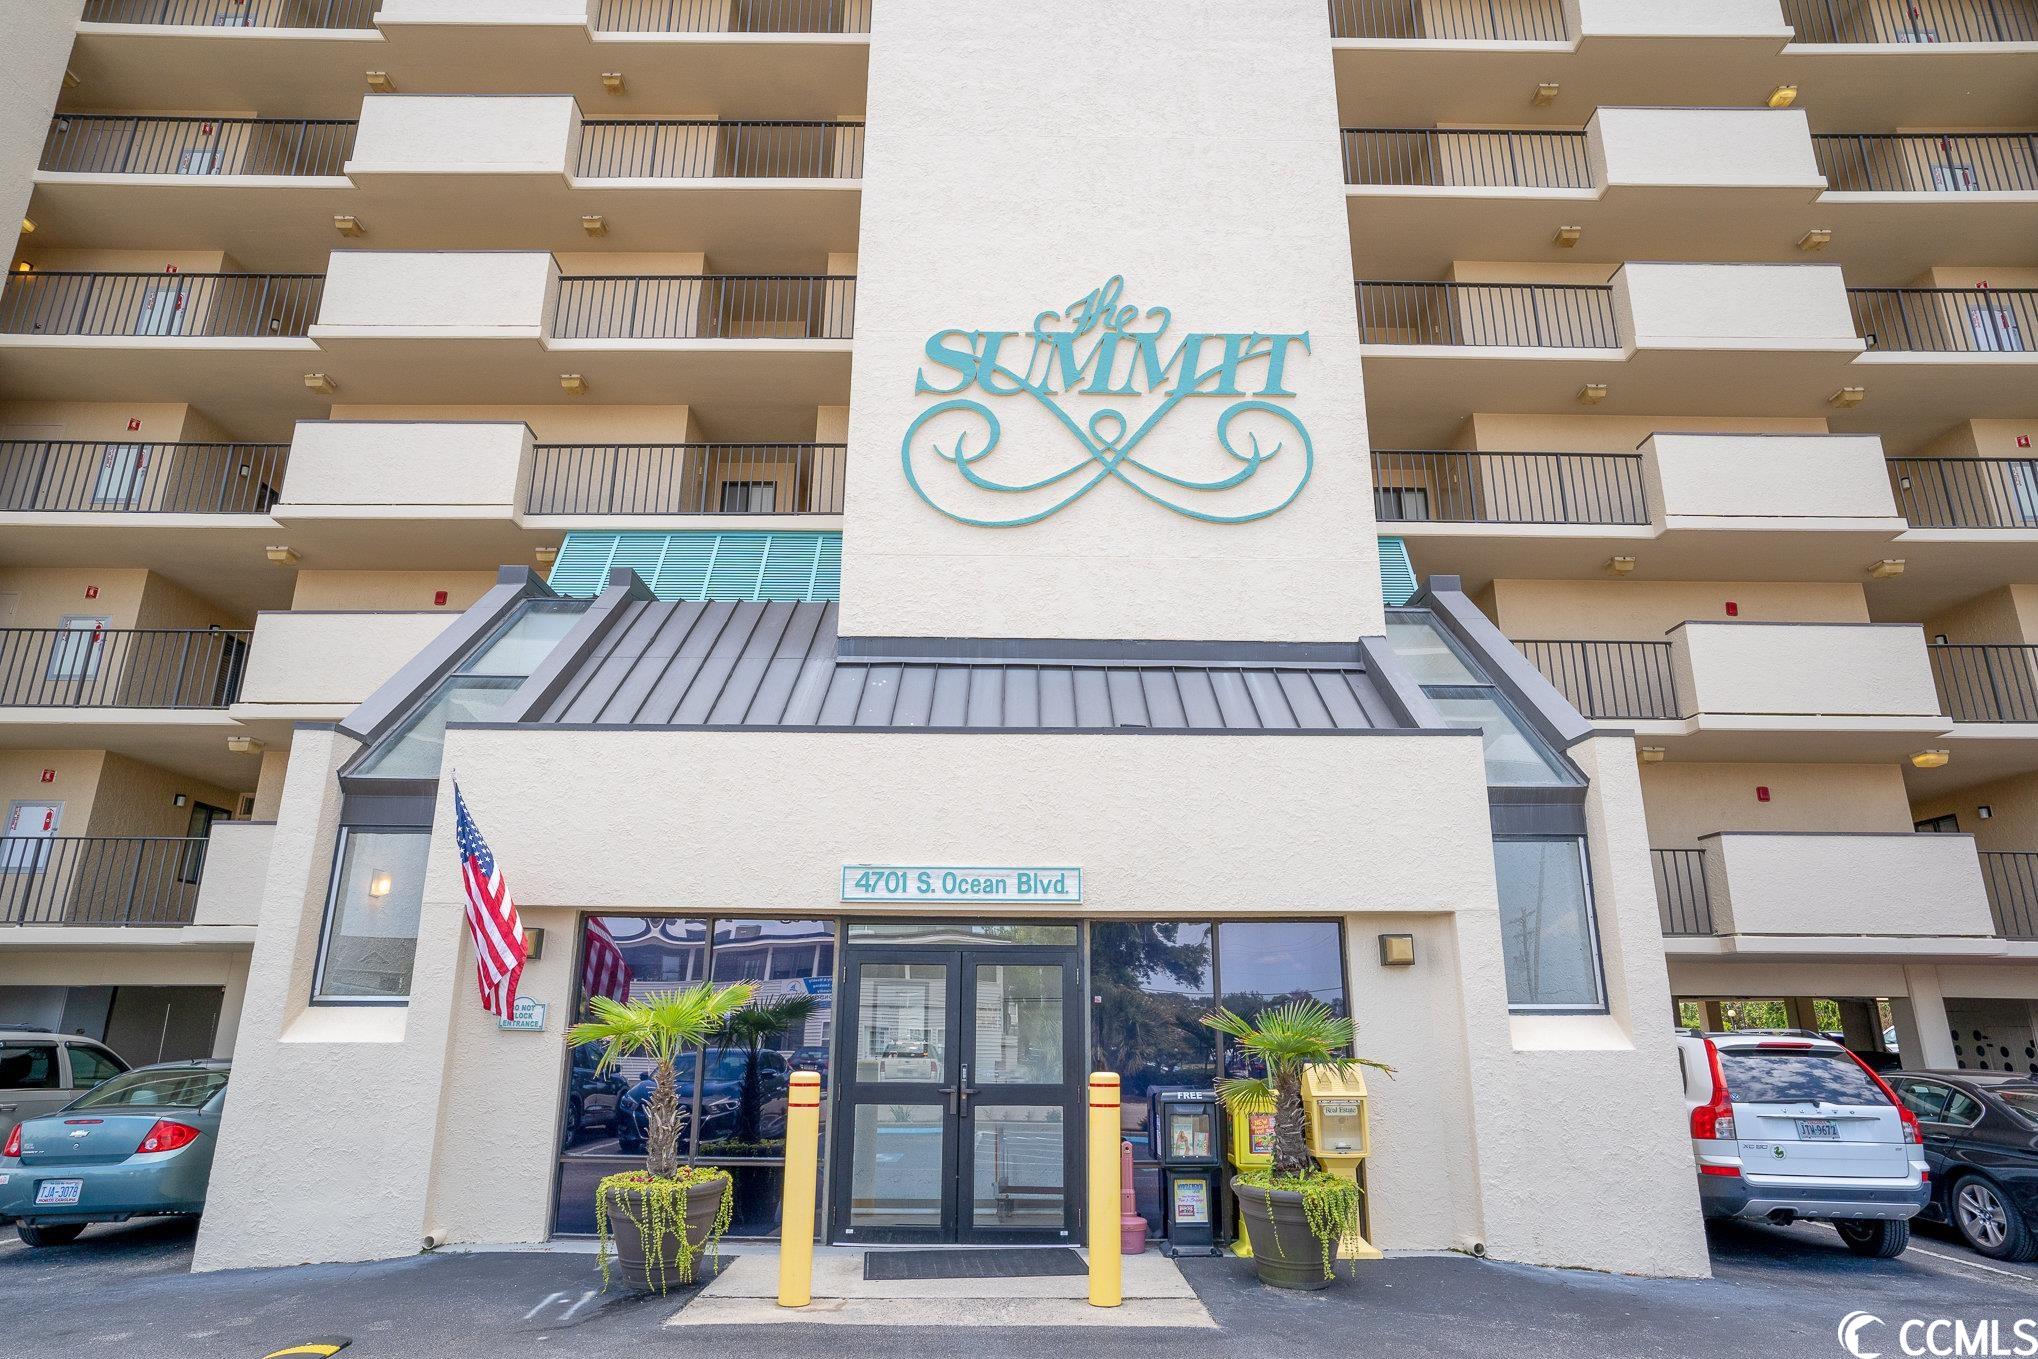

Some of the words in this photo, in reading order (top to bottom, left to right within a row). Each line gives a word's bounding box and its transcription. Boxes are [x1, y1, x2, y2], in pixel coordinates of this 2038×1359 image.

[915, 329, 1311, 397] SUMMIT
[855, 871, 907, 894] 4701
[917, 871, 936, 894] S.
[942, 871, 1007, 895] Ocean
[1016, 872, 1069, 895] Blvd.
[502, 1019, 539, 1028] ENTRANCE
[1177, 1091, 1203, 1100] FREE
[1325, 1106, 1338, 1114] Real
[1339, 1106, 1357, 1114] Estate
